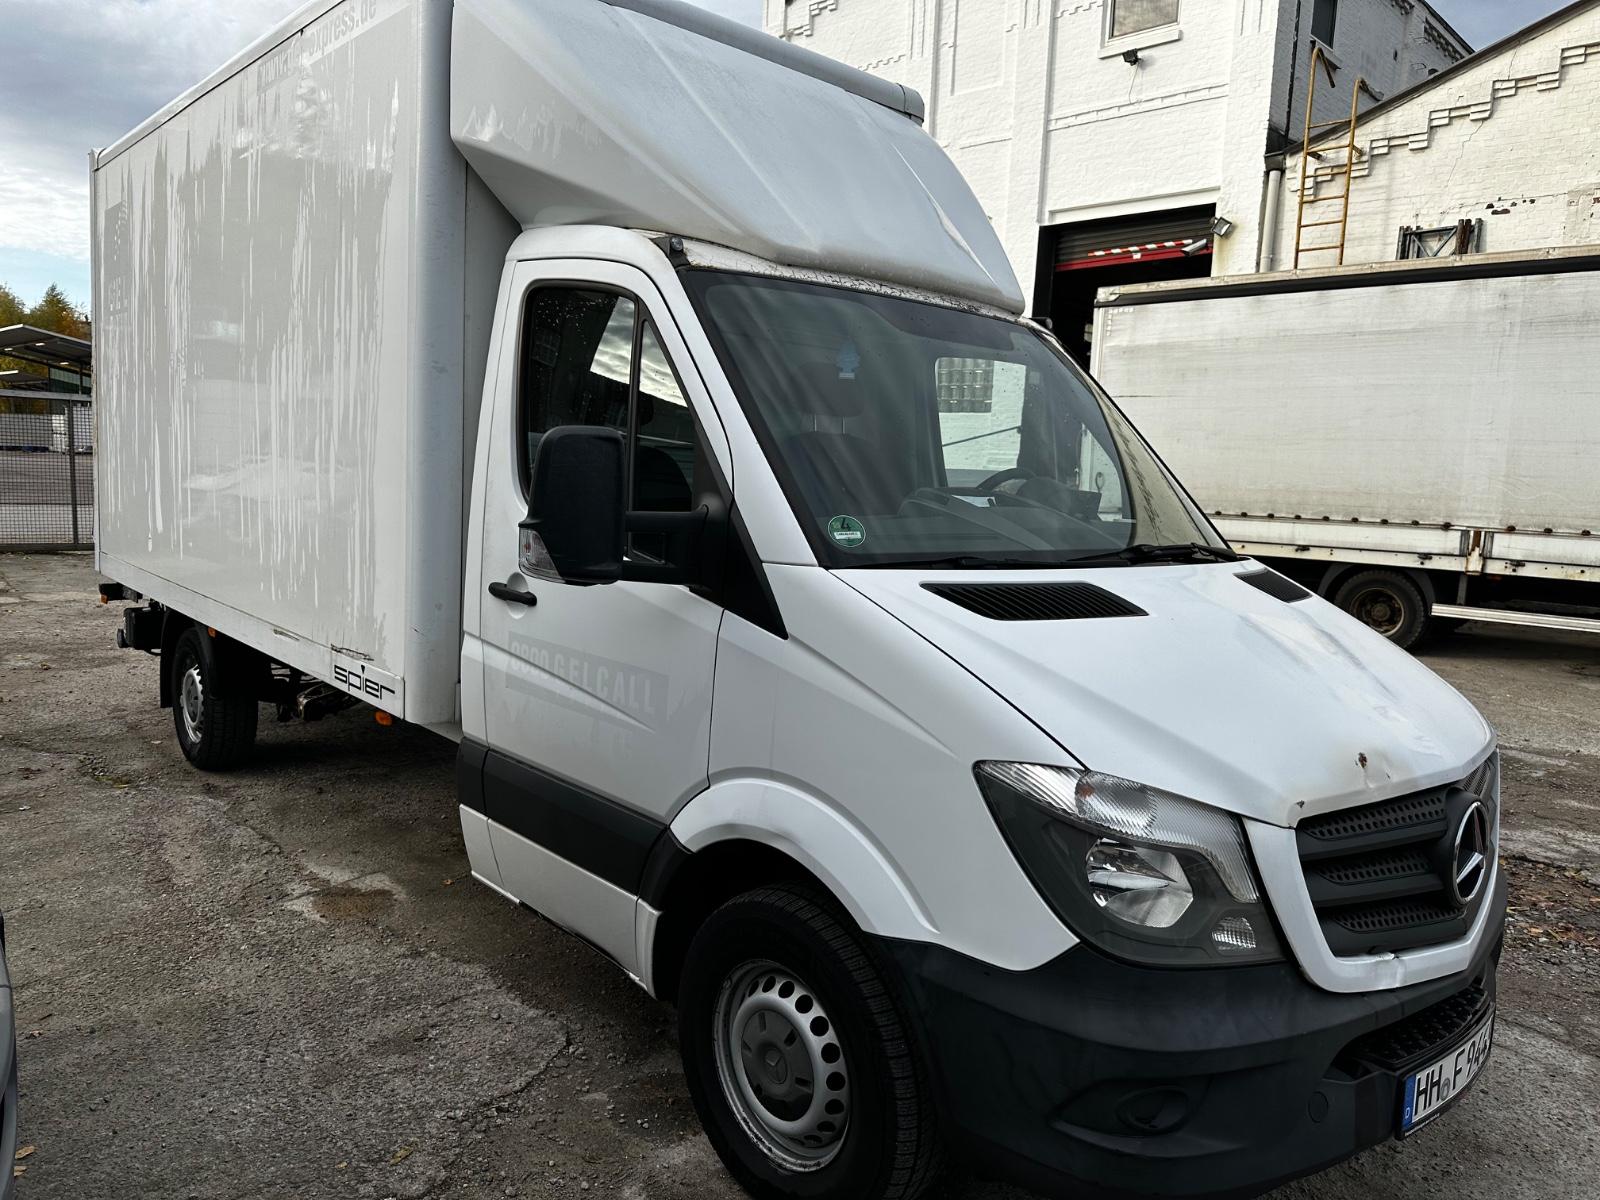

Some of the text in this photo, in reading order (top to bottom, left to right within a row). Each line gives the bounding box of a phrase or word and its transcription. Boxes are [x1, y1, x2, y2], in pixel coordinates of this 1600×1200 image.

[333, 664, 396, 701] spier
[1403, 1108, 1411, 1119] D
[1413, 1064, 1443, 1116] HH
[1451, 1047, 1466, 1091] F
